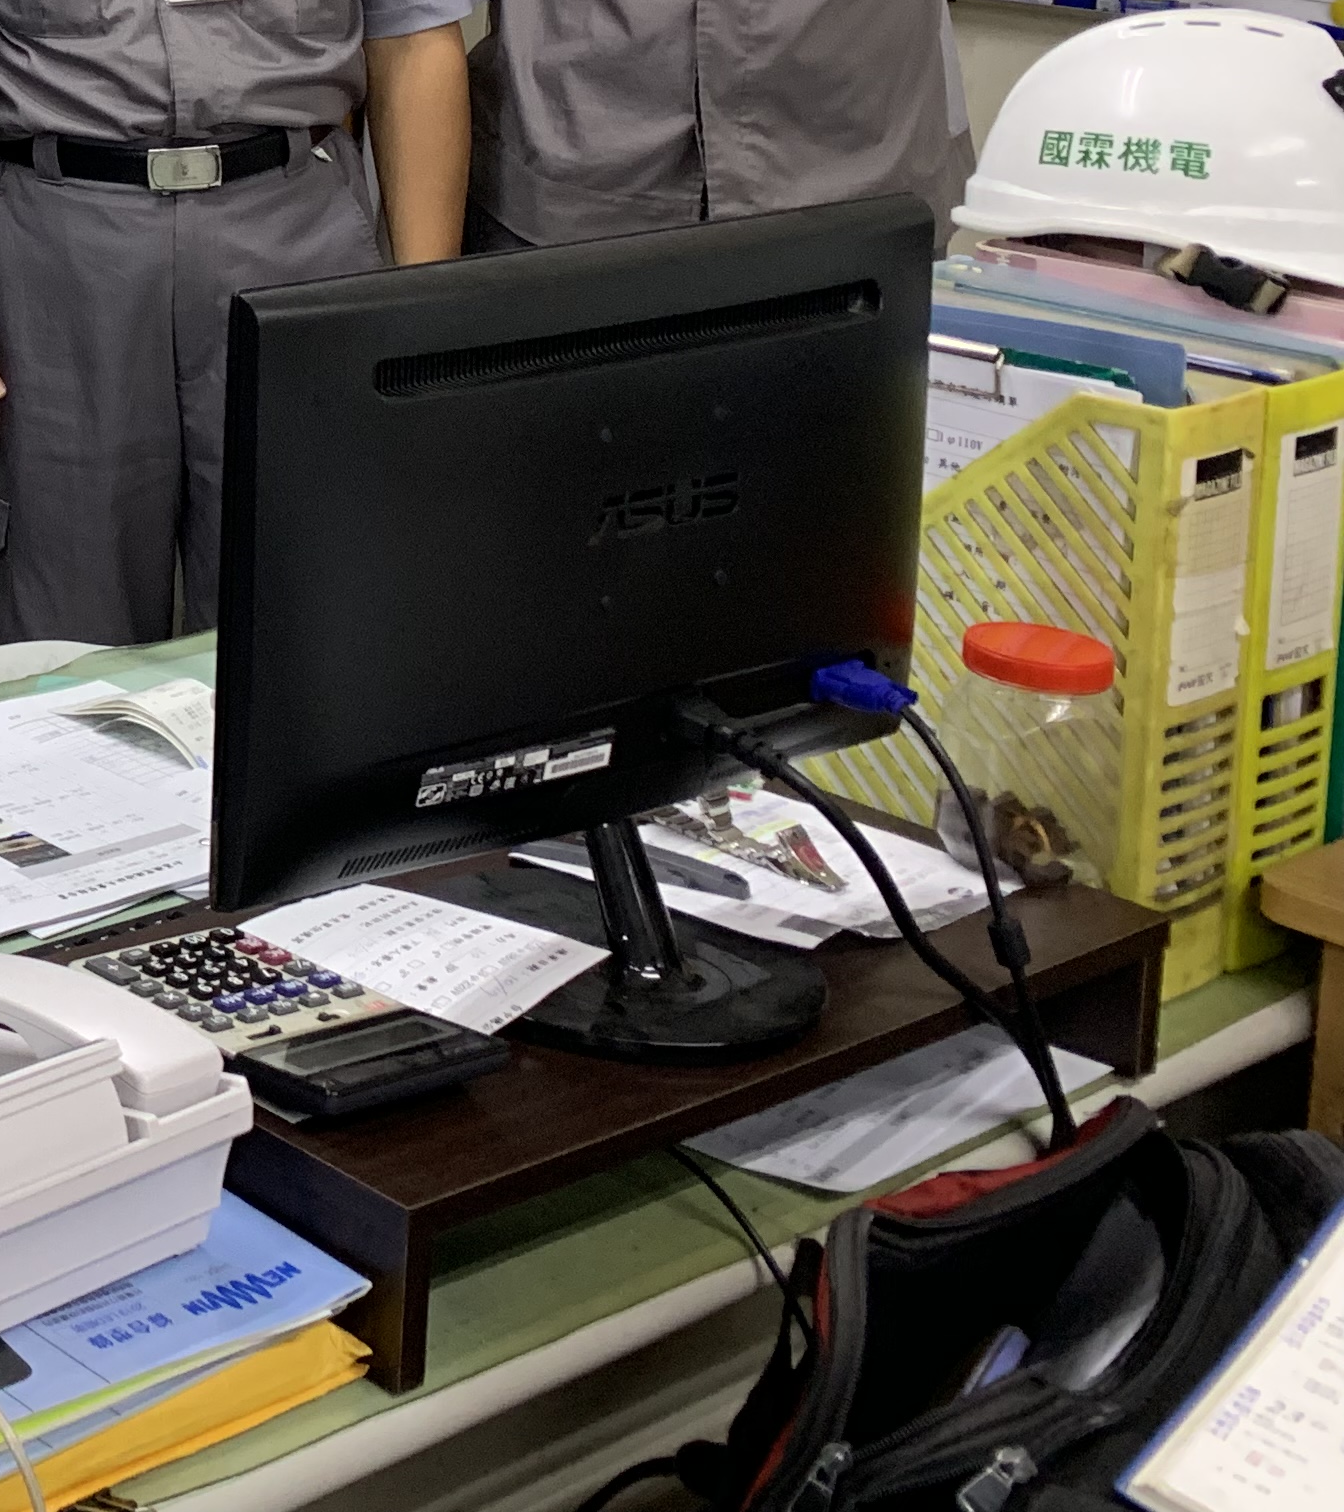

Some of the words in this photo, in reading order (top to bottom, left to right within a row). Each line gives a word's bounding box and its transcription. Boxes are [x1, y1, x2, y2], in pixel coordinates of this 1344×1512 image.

[1038, 129, 1212, 180] 國霖機電
[587, 470, 741, 547] ASUS
